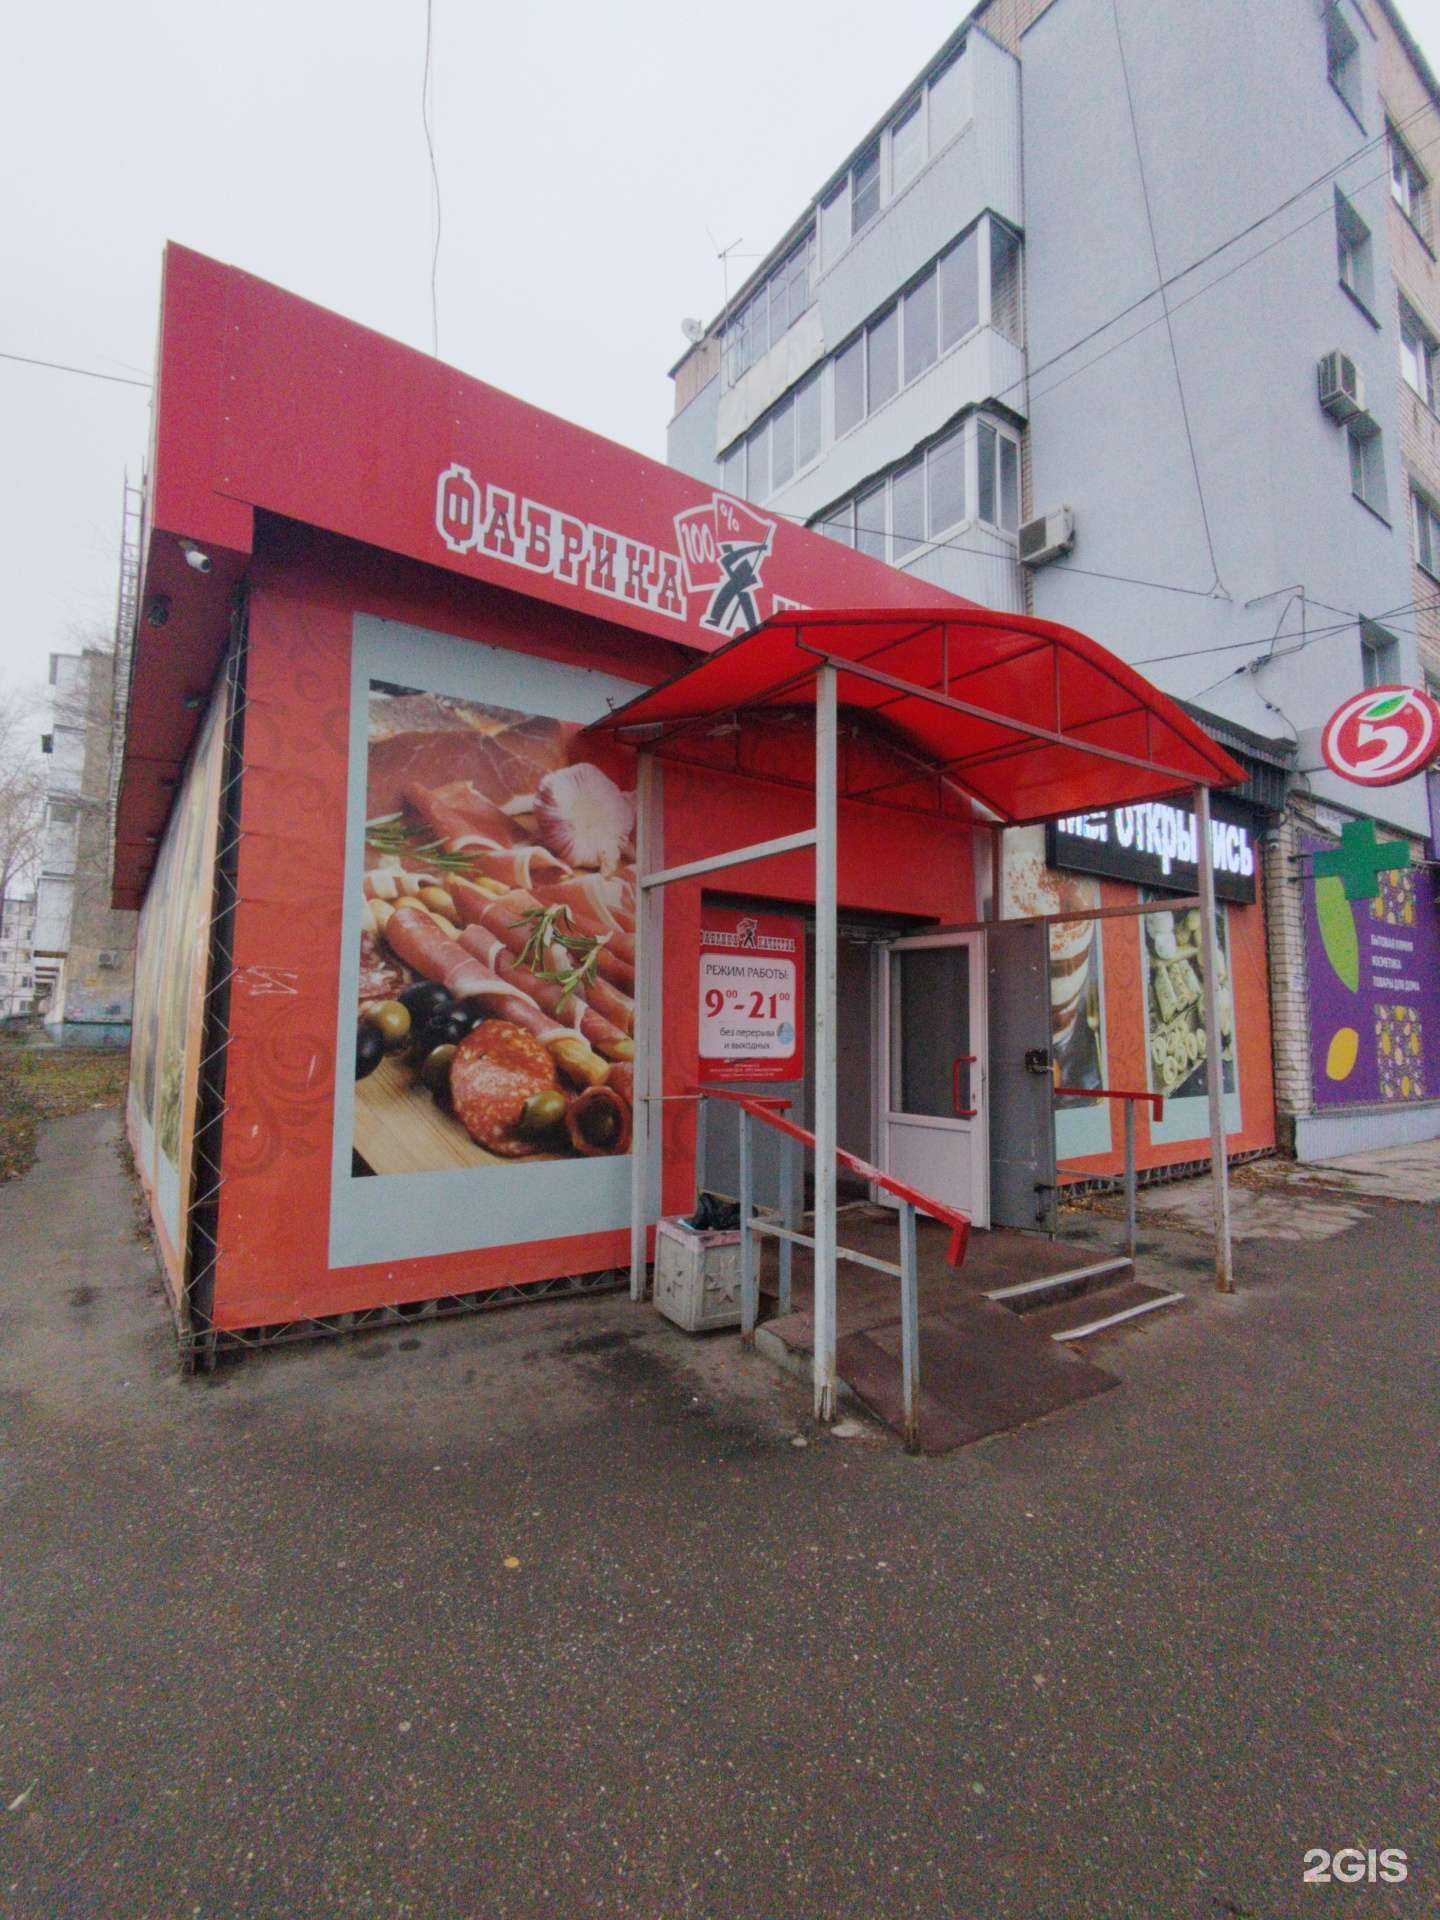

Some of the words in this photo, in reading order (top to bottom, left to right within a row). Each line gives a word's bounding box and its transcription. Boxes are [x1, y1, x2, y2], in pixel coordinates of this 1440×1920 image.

[436, 463, 687, 621] ФАБРИКА
[706, 964, 745, 977] РЕЖИМ
[747, 967, 788, 980] РАБОТЫ
